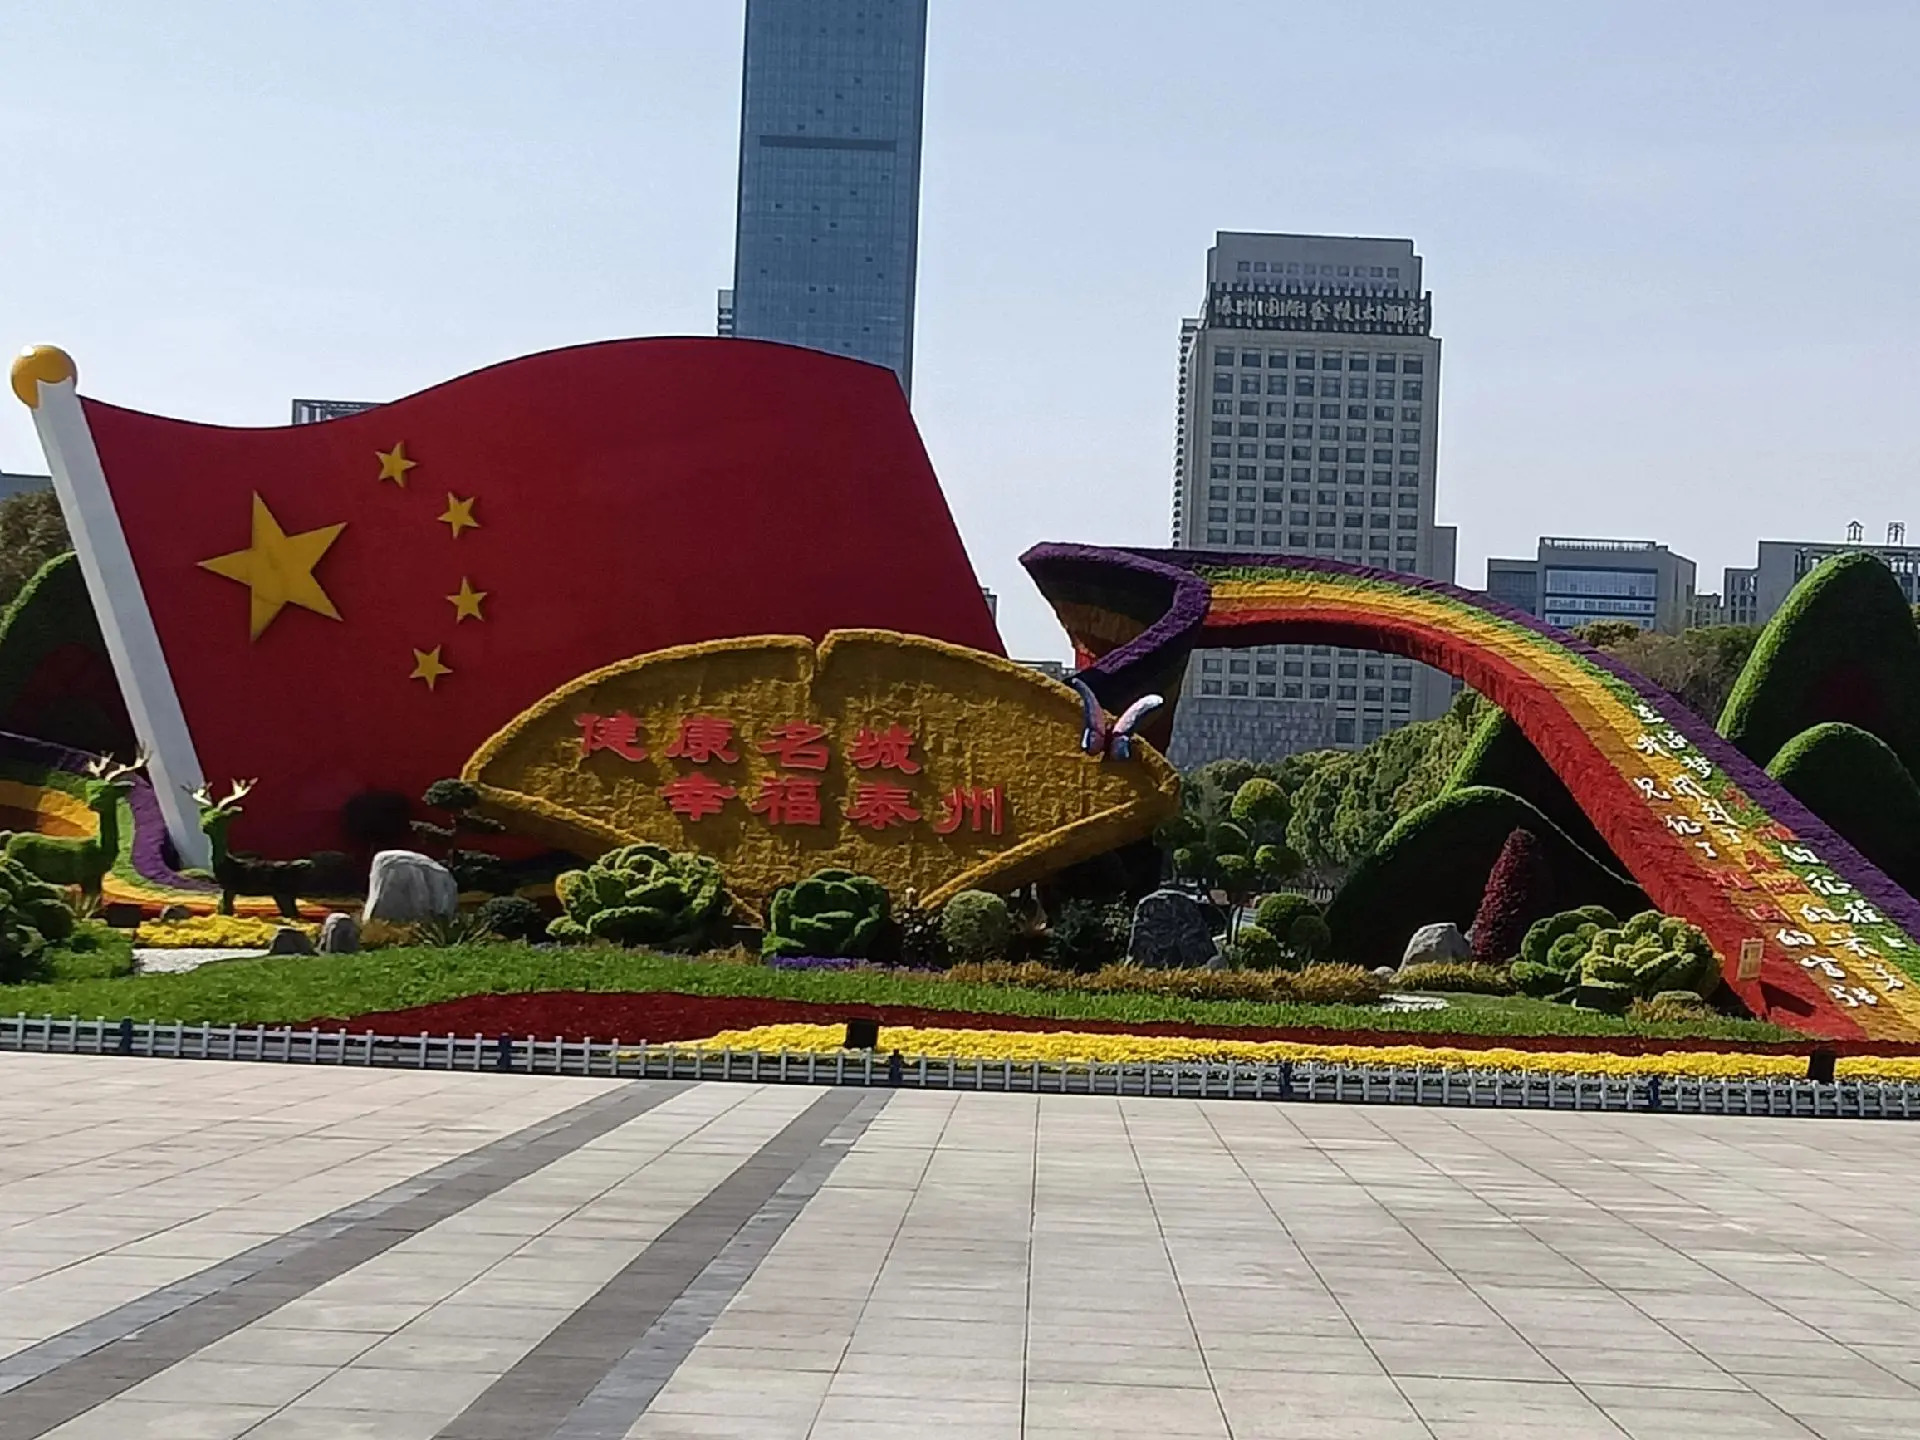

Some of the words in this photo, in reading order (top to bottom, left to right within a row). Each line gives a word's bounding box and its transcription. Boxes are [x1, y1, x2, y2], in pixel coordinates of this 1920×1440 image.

[574, 710, 921, 775] 健康名城
[659, 771, 1003, 836] 幸福泰州
